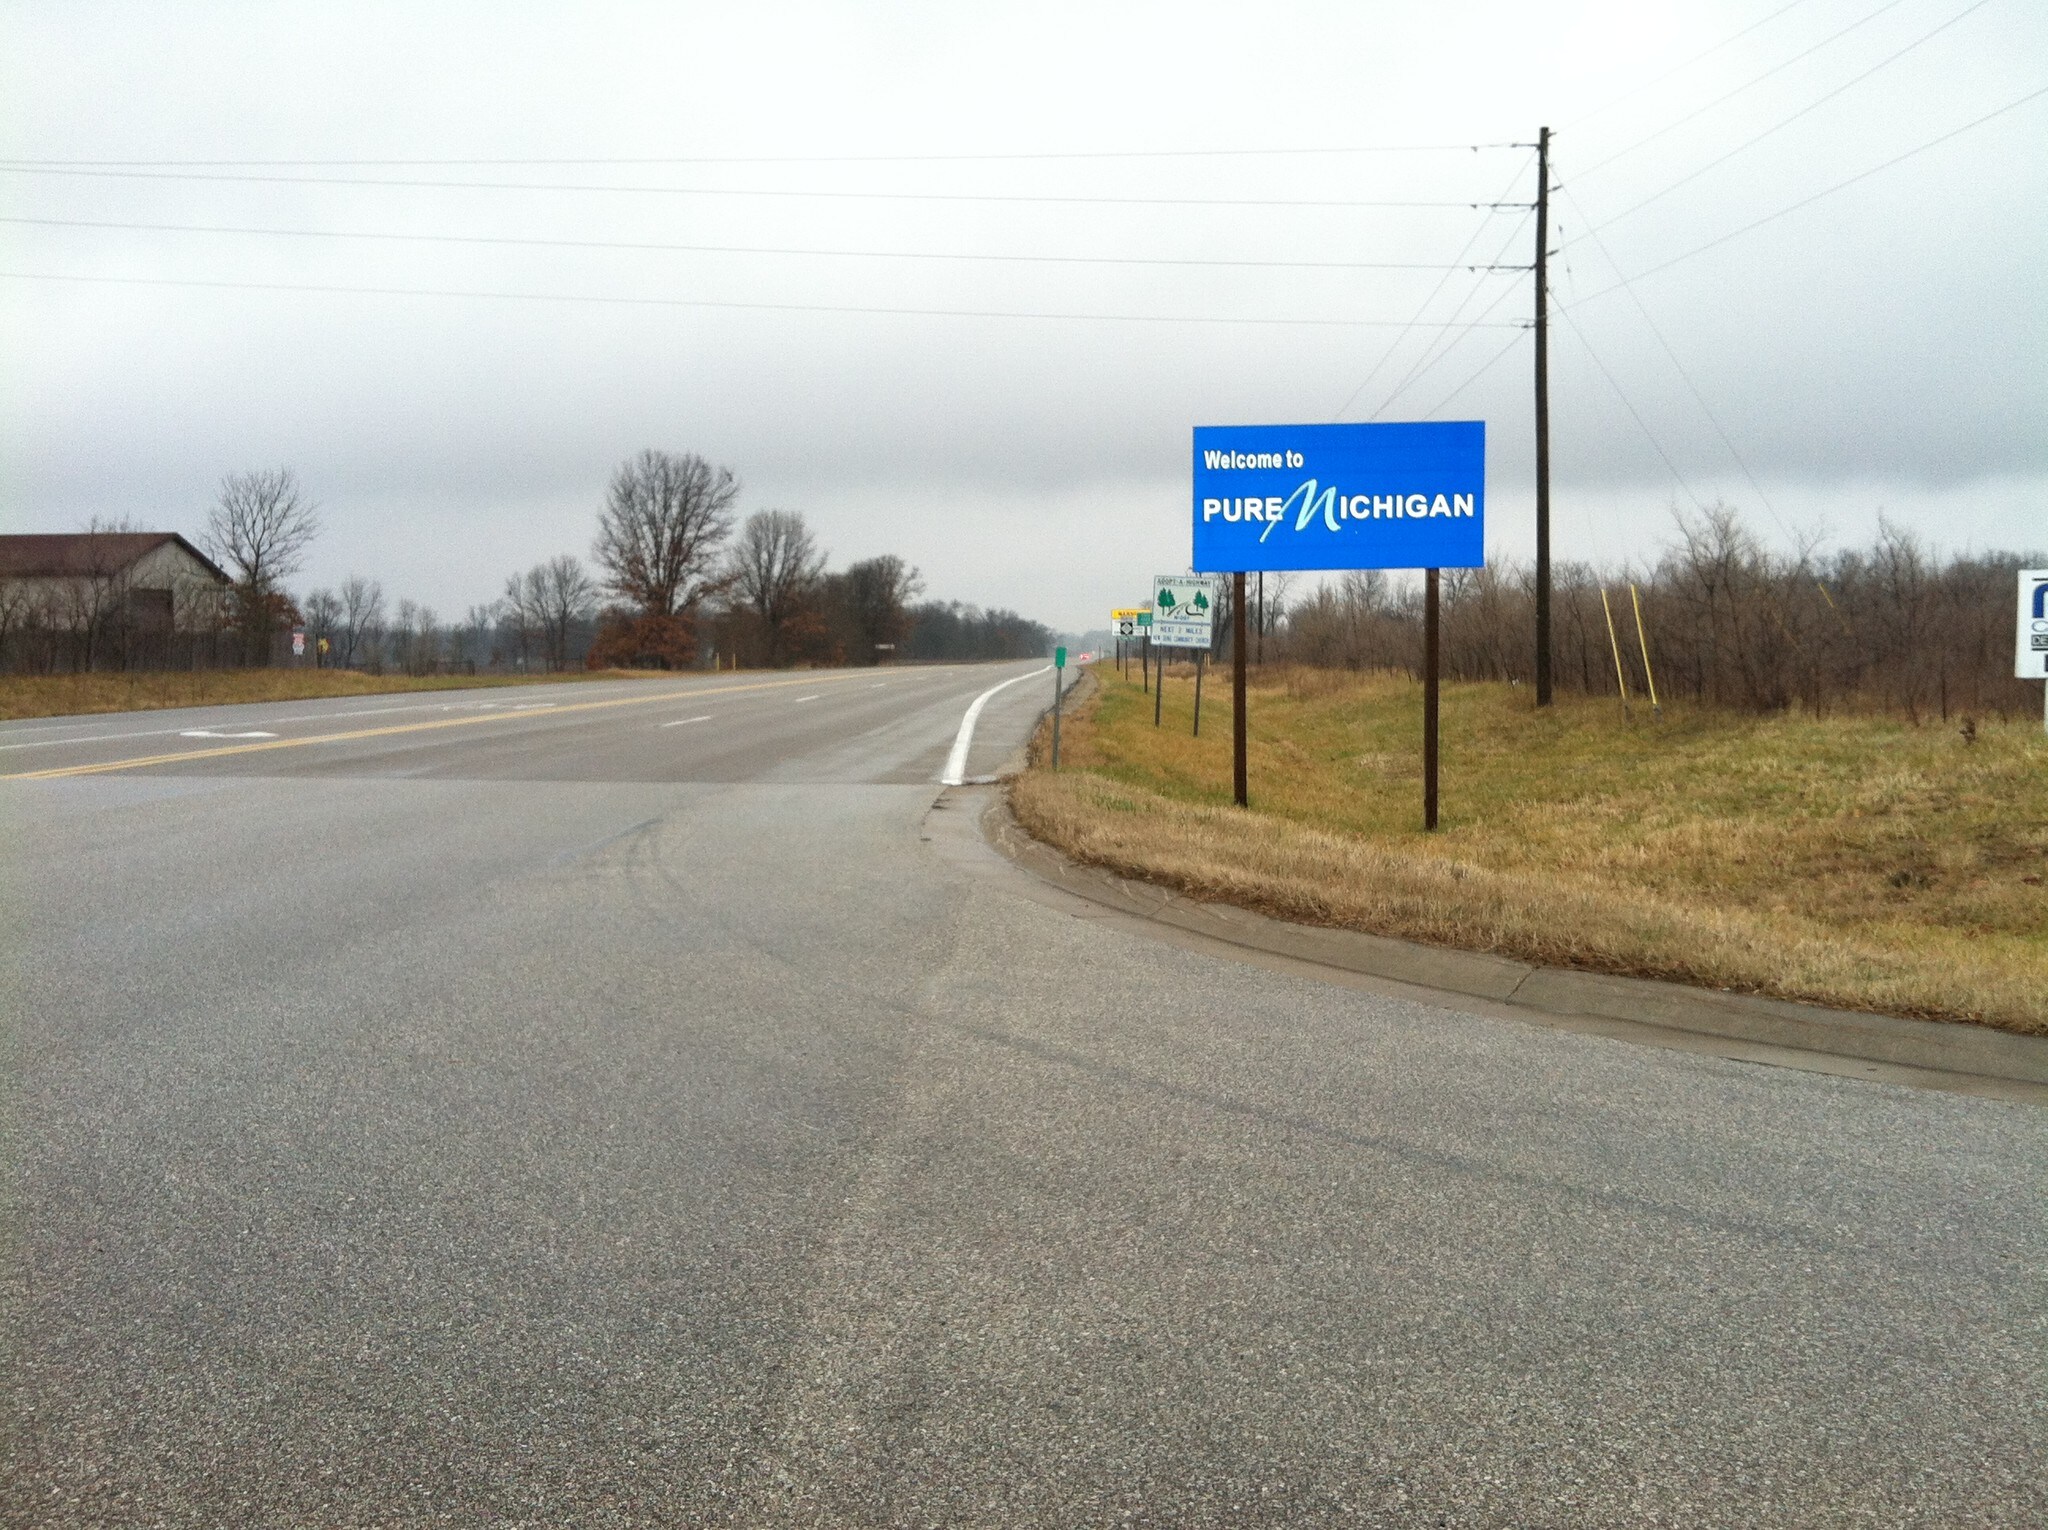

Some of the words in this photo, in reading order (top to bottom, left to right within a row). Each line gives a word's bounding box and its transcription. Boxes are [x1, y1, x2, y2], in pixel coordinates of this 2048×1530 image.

[1204, 450, 1282, 469] Welcome
[1286, 449, 1304, 468] to
[1203, 497, 1283, 522] PURE
[1260, 479, 1474, 543] MICHIGAN
